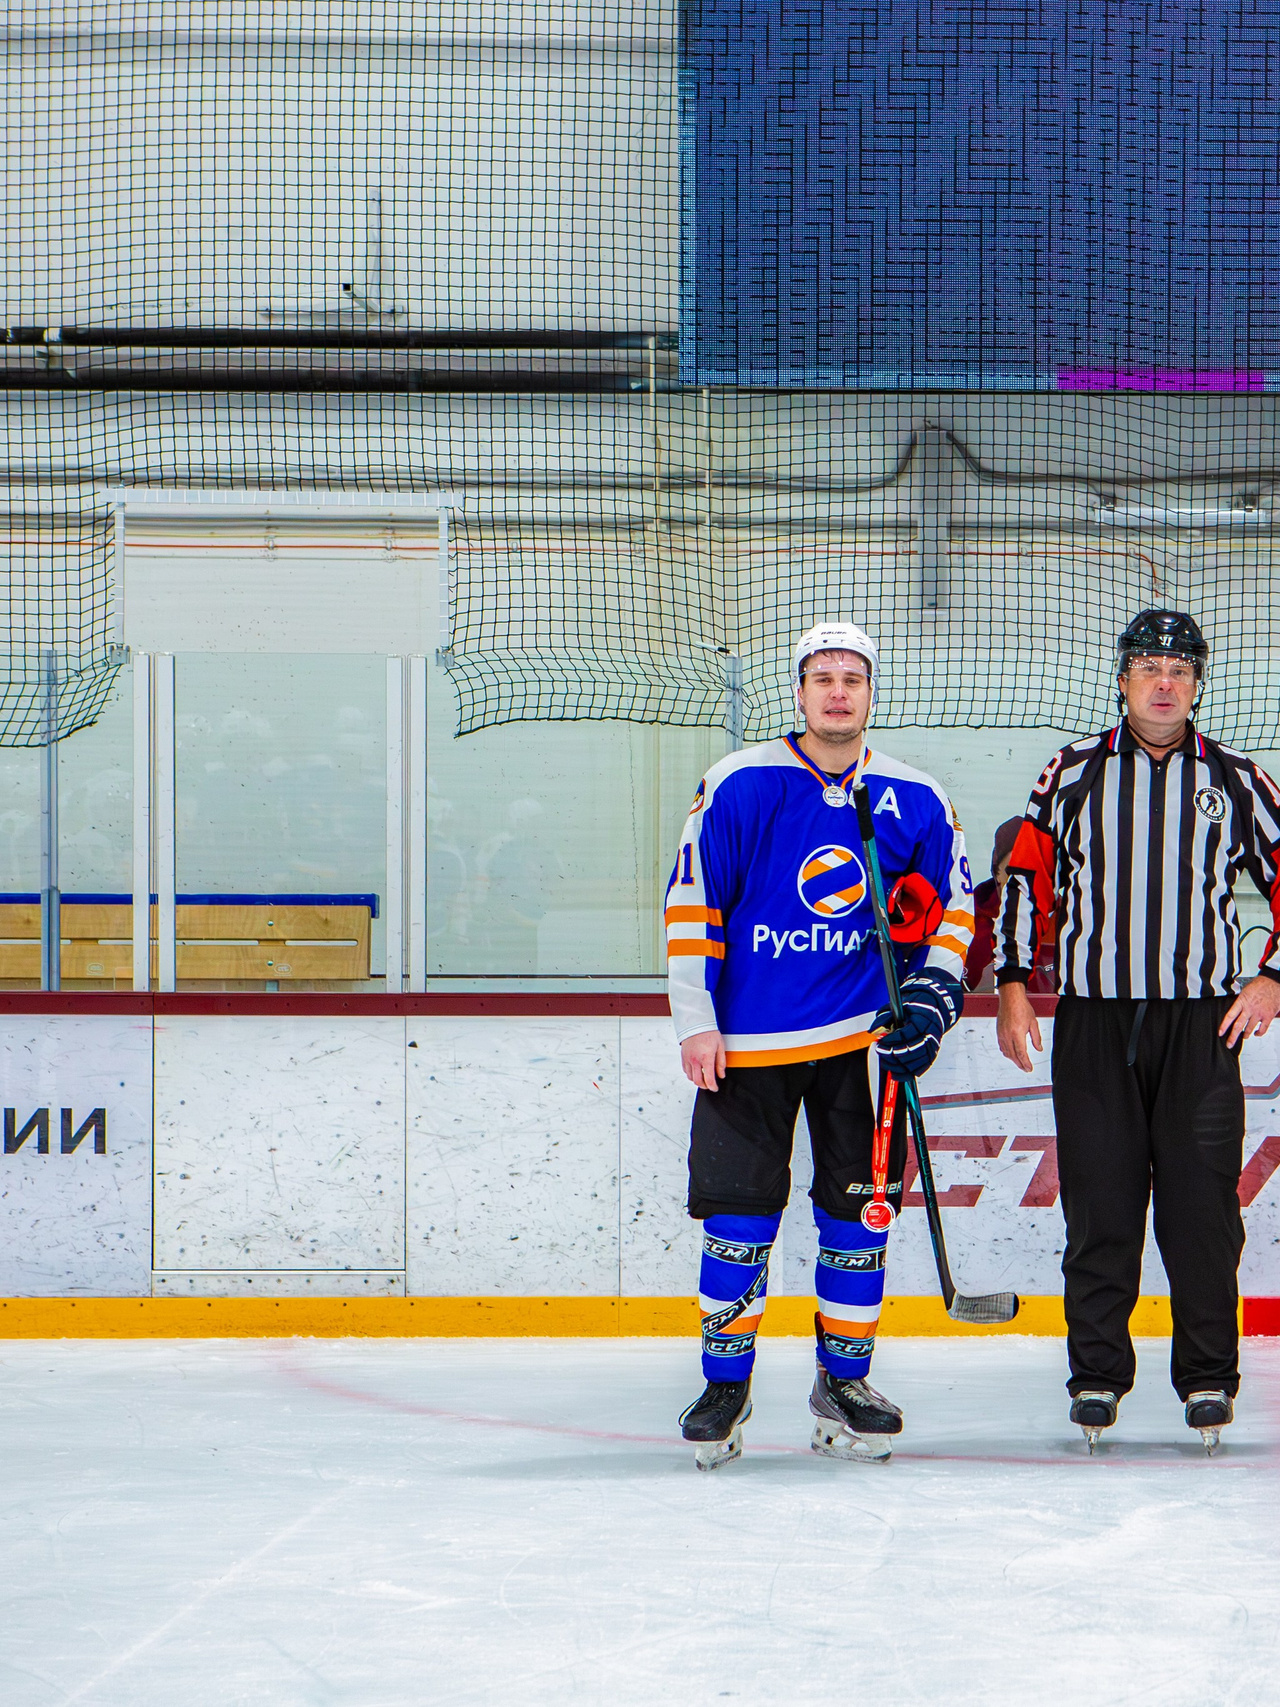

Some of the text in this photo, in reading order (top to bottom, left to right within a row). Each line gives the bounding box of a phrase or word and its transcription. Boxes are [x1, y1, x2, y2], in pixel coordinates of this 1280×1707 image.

[753, 923, 877, 958] РусГид
[846, 1181, 902, 1195] BAER
[709, 1338, 754, 1352] CCM
